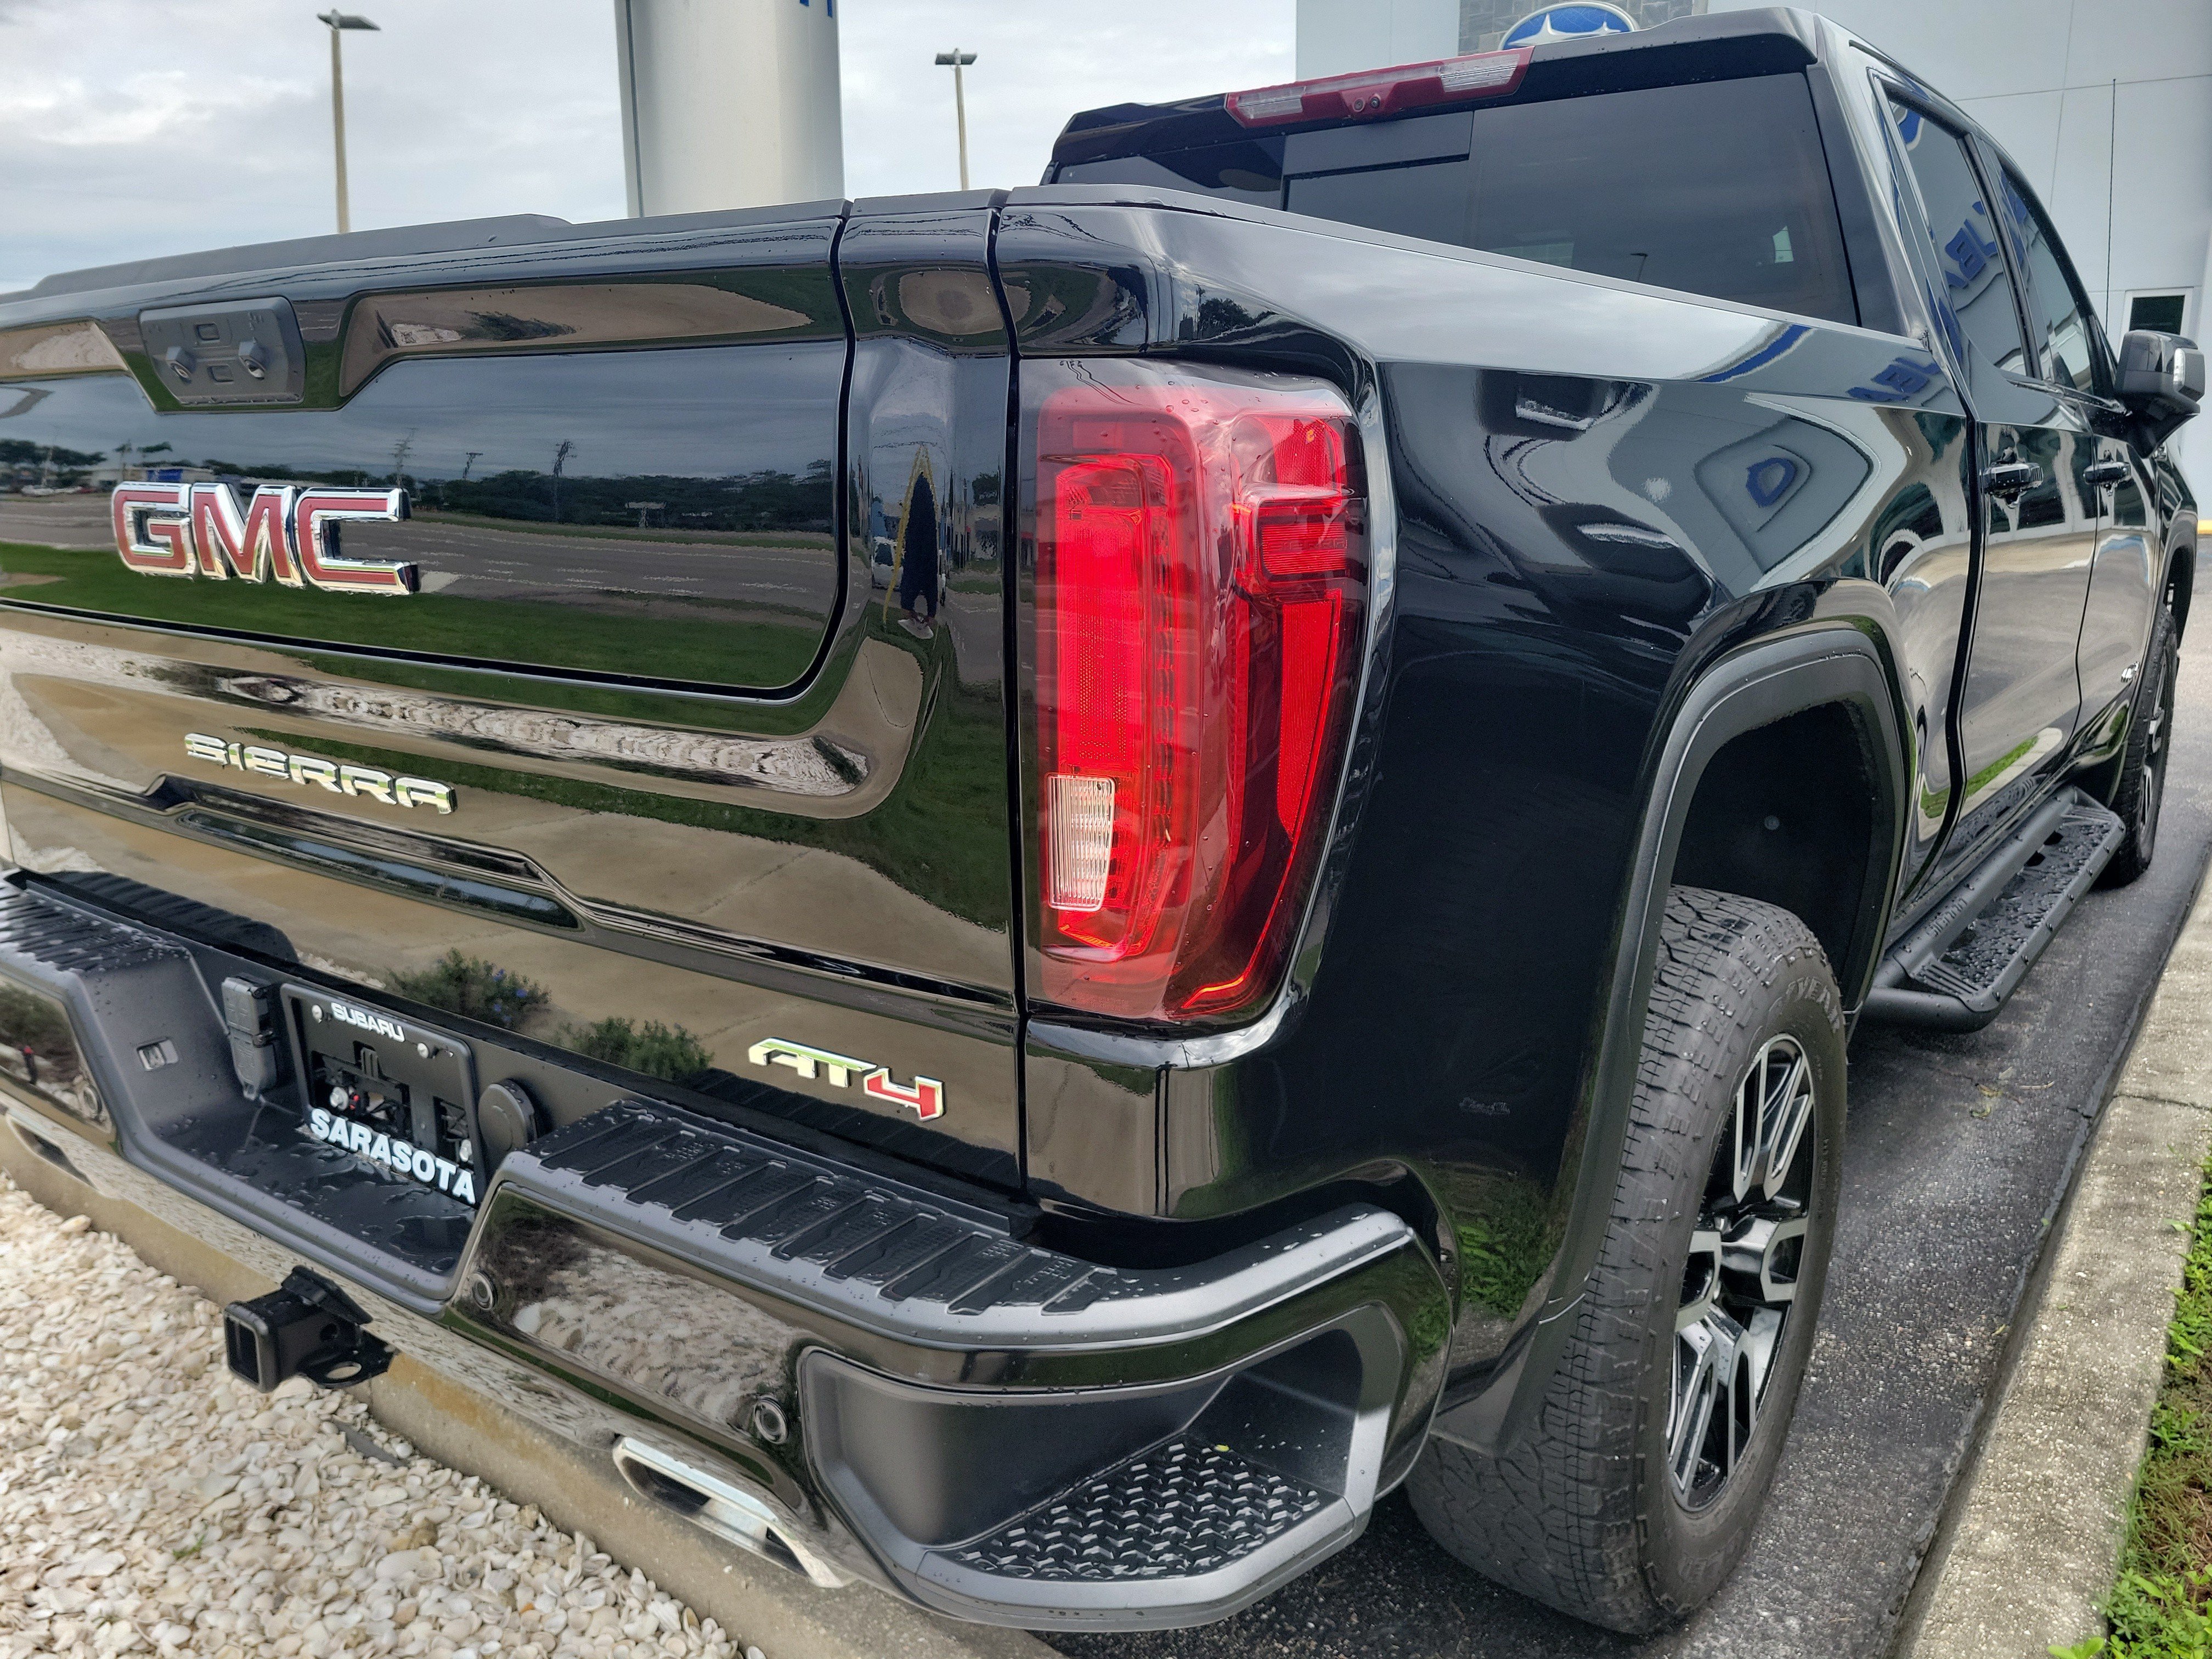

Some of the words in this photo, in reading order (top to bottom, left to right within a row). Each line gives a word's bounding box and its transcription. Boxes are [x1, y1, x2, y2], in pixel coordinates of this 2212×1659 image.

[111, 480, 420, 596] GMC
[184, 732, 458, 815] SIERRA
[330, 1001, 405, 1042] SUBARU
[748, 1037, 945, 1122] AT4
[310, 1107, 476, 1205] SARASOTA
